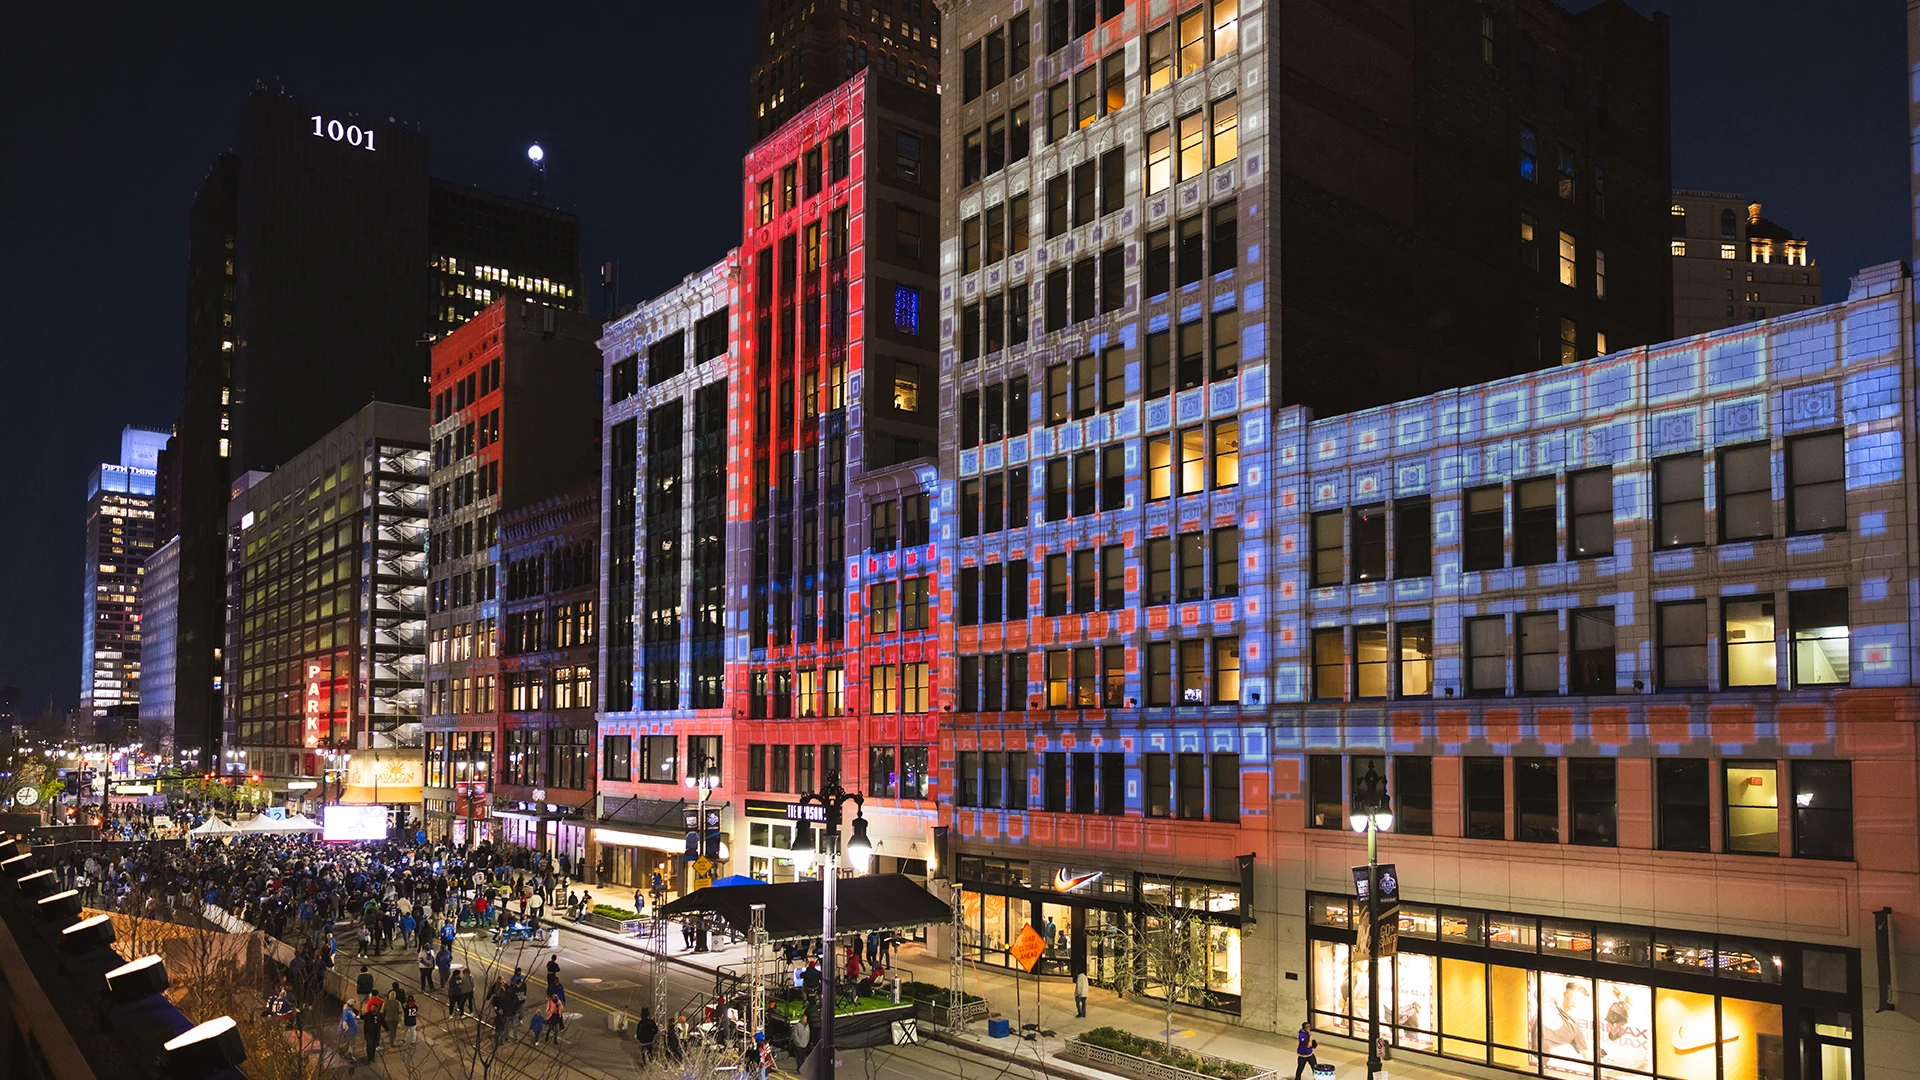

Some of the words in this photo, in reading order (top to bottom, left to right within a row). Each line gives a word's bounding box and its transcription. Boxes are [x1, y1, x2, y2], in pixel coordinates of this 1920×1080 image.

[311, 115, 376, 151] 1001
[102, 463, 127, 472] FIFTH
[129, 466, 157, 476] THIRD
[307, 665, 320, 730] PARK
[378, 772, 414, 781] AVALON
[1018, 943, 1038, 952] CLOSED
[1020, 951, 1038, 961] AHEAD
[408, 1008, 416, 1017] 12
